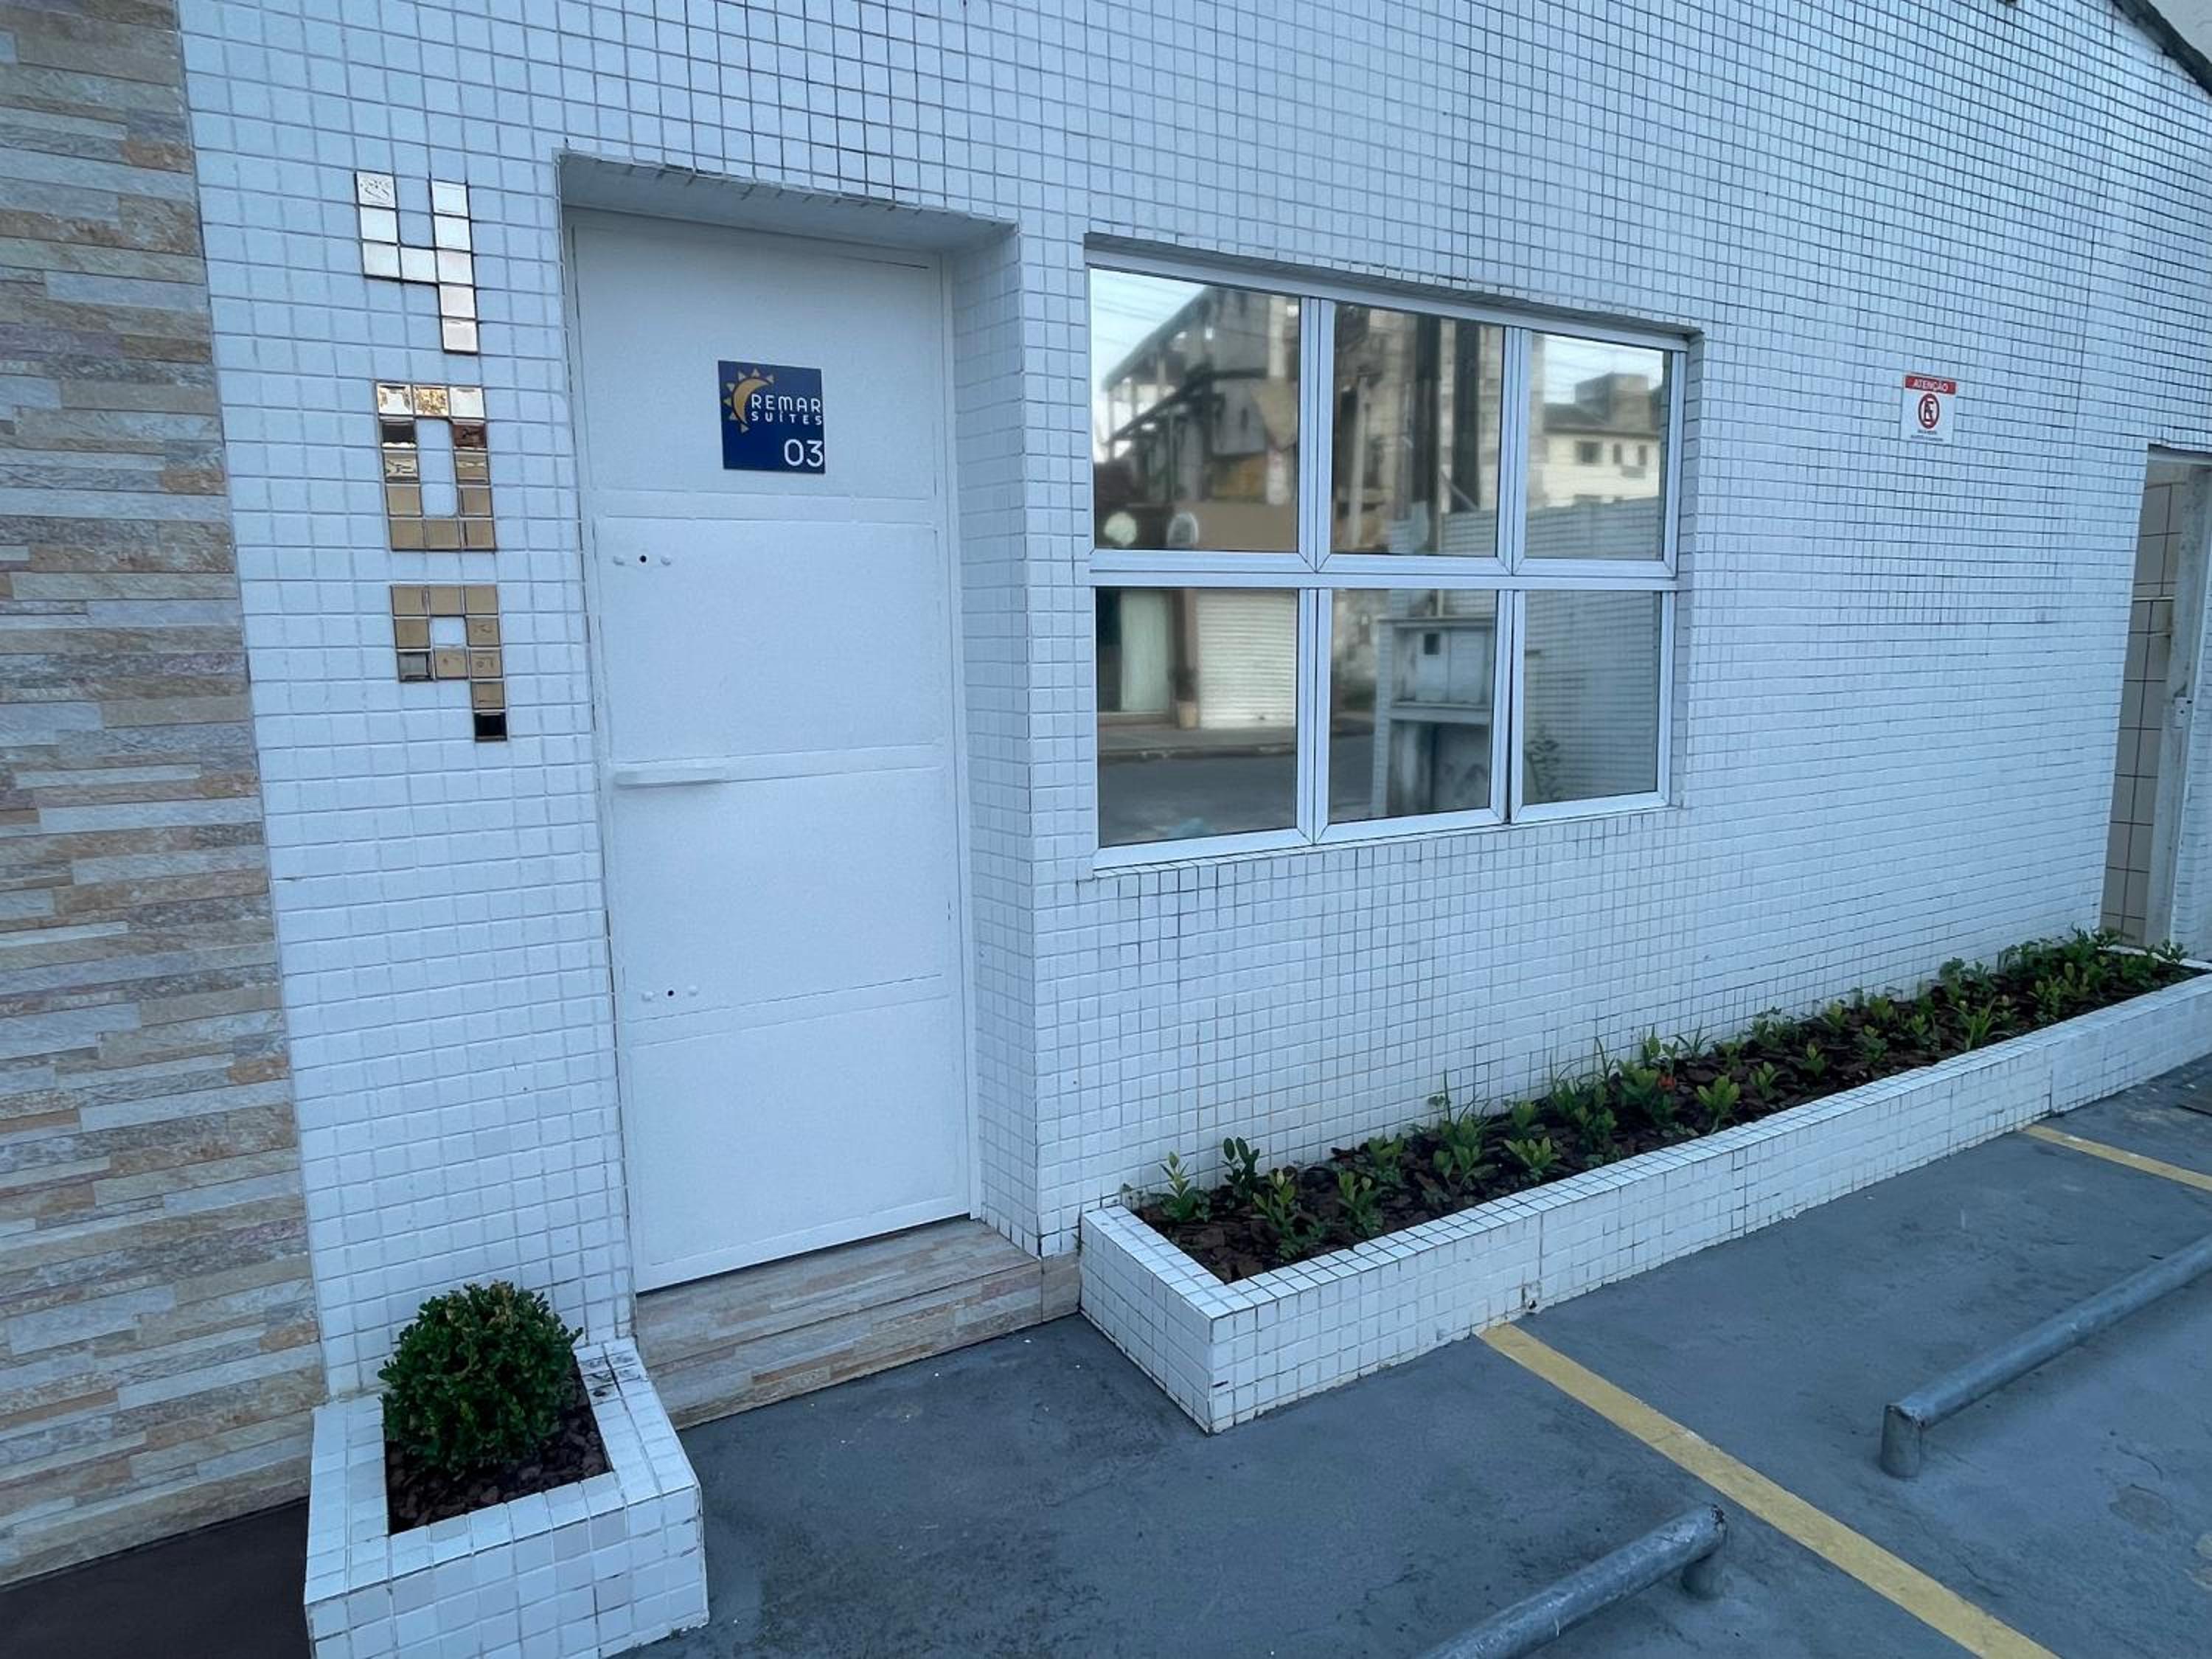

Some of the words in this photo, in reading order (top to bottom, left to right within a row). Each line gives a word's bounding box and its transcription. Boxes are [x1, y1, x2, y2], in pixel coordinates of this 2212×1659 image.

[751, 394, 821, 413] REMAR
[356, 170, 507, 740] 409
[784, 439, 824, 467] 03
